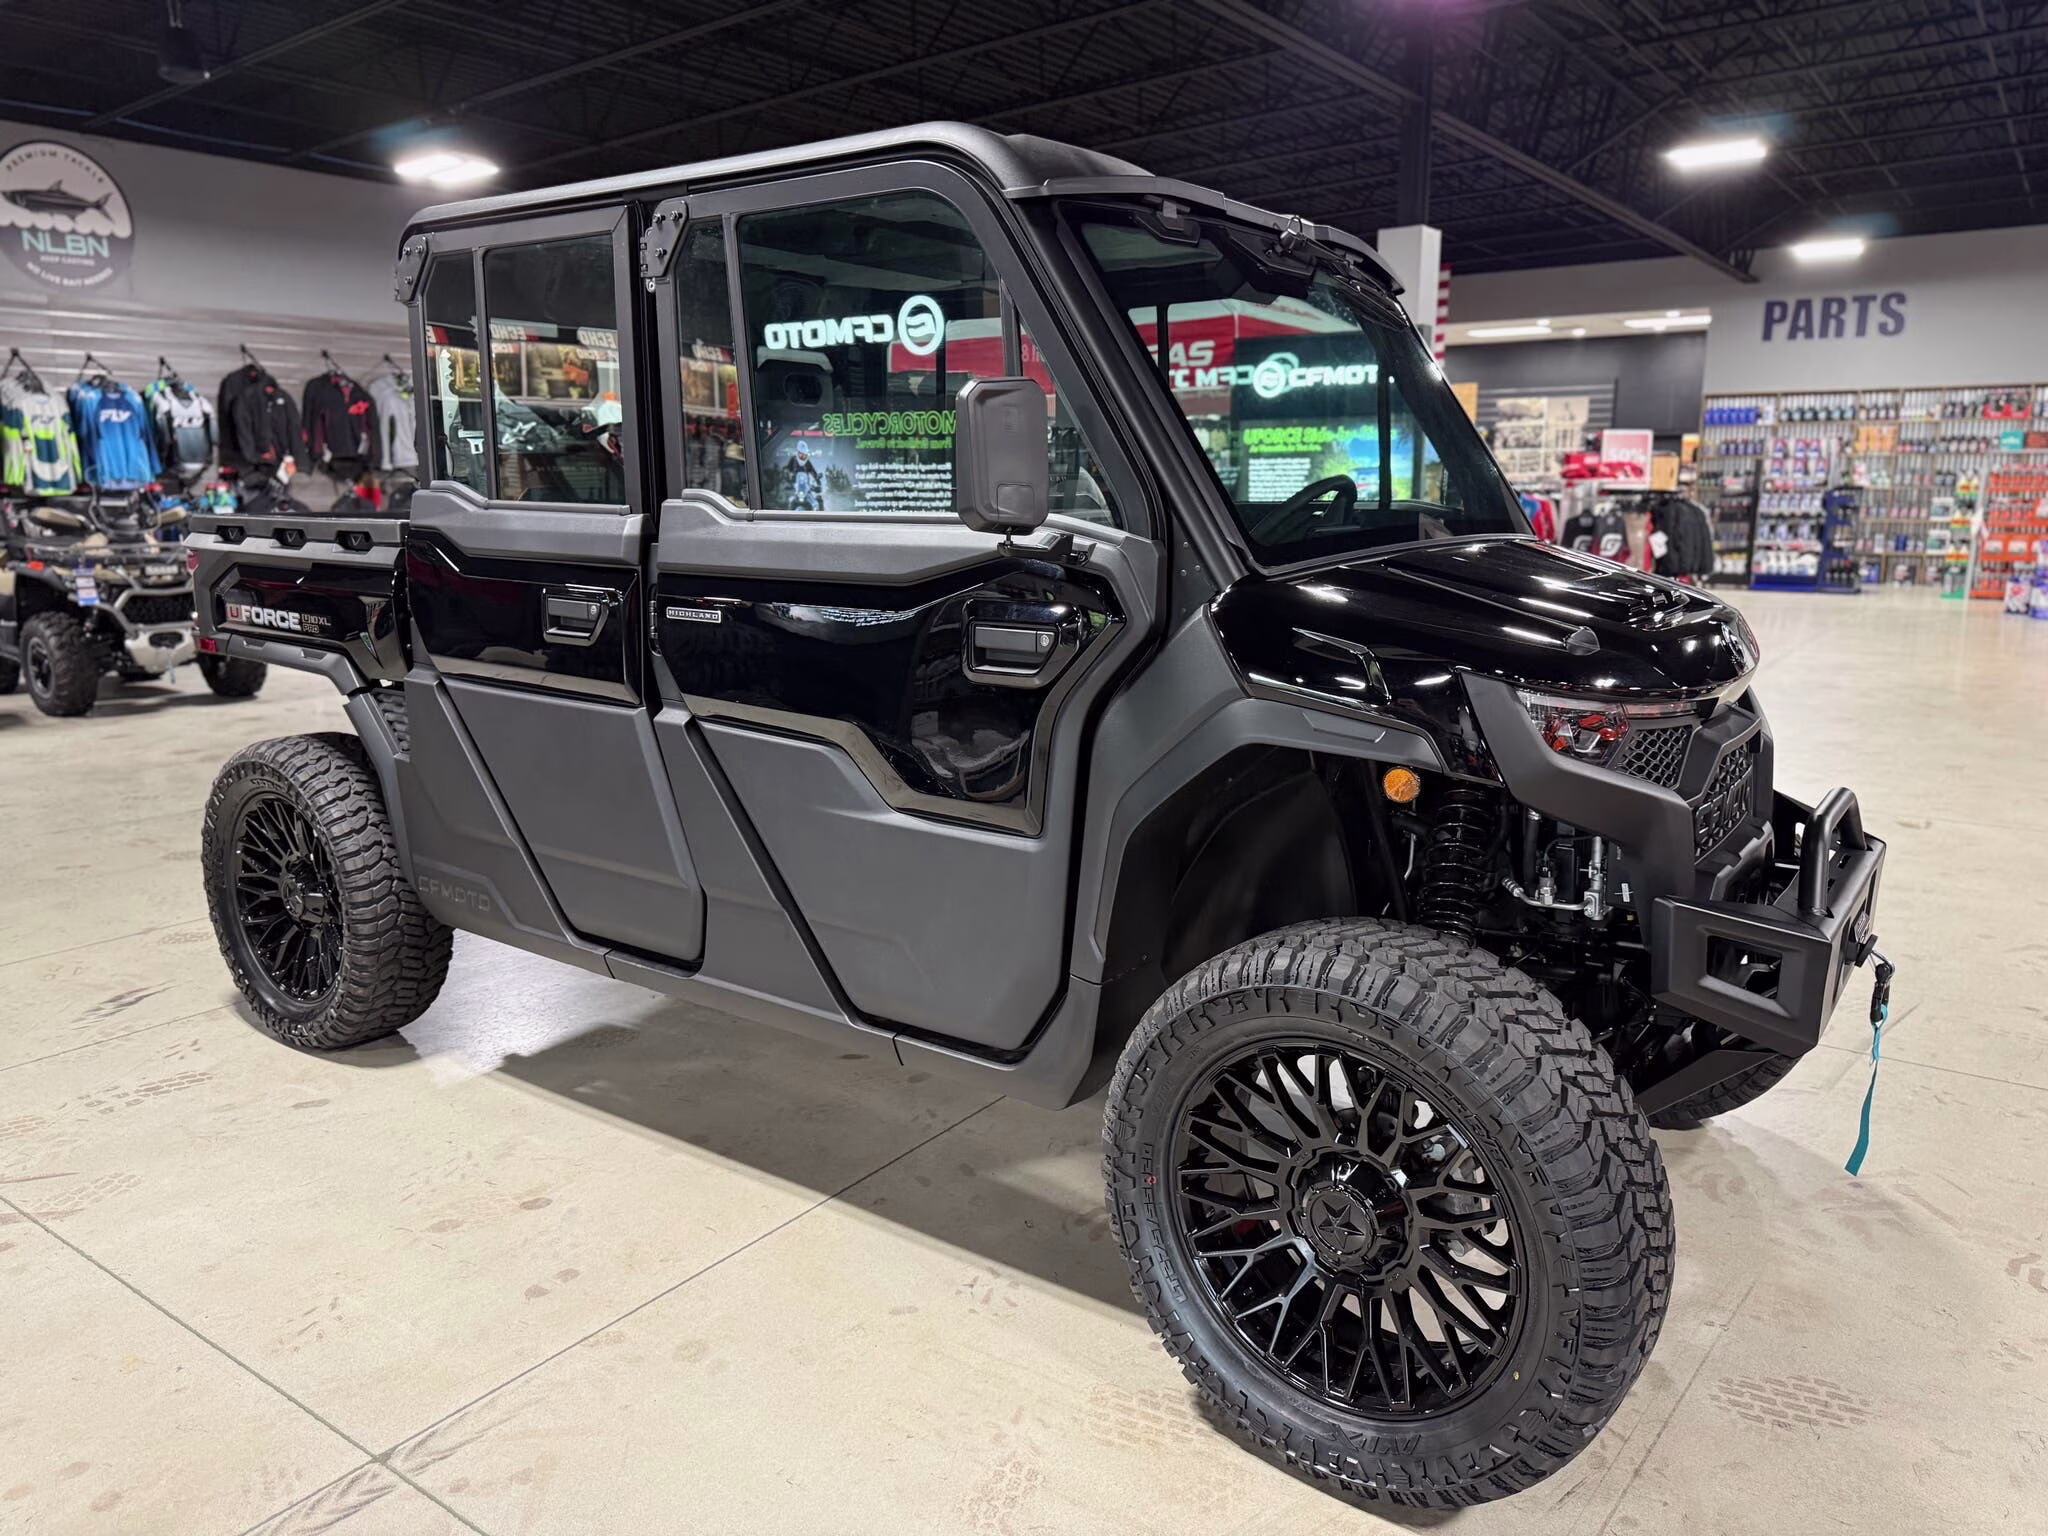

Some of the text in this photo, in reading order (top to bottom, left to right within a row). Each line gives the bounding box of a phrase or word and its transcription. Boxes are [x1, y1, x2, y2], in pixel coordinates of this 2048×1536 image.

[21, 230, 110, 258] NLBN
[1762, 292, 1907, 341] PARTS
[1288, 364, 1394, 388] CFMOT
[31, 415, 55, 425] FLY
[99, 408, 132, 423] FLY
[226, 603, 302, 631] UFORCE
[668, 609, 719, 620] HIGHLAND
[418, 876, 490, 912] CFMOTO
